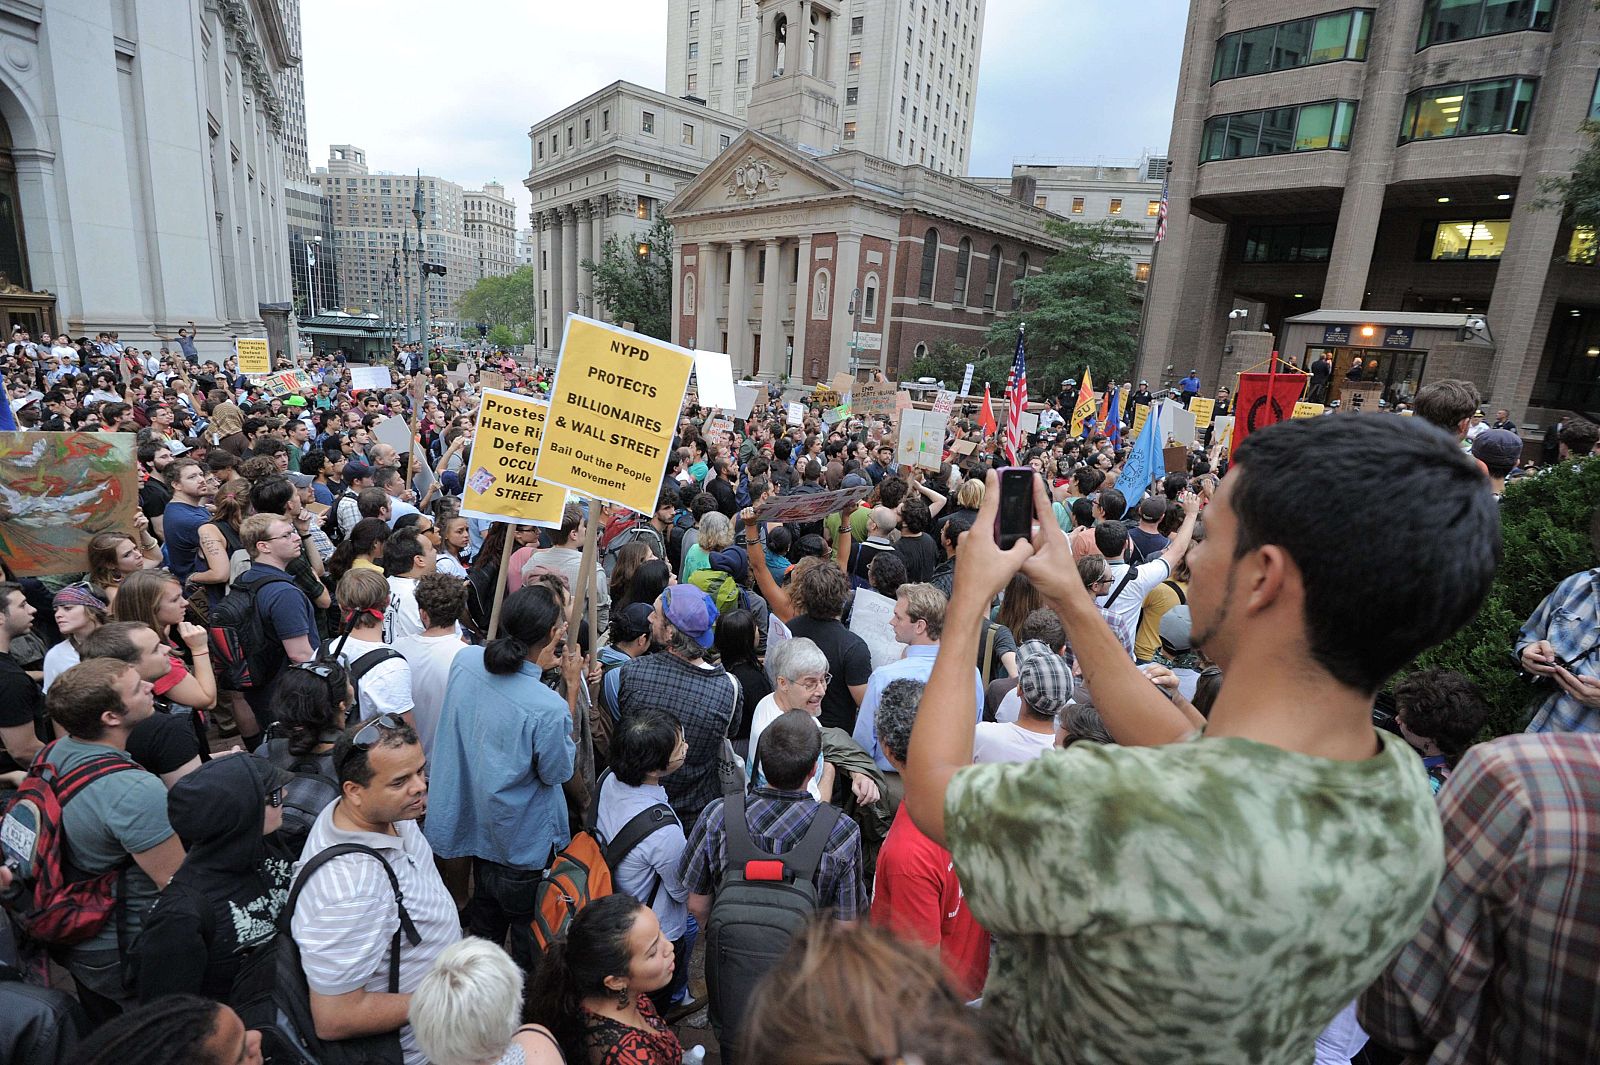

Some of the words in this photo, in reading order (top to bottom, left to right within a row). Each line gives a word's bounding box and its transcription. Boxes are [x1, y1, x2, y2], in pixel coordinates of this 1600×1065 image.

[610, 340, 649, 362] NYPD
[280, 372, 302, 390] MY
[587, 366, 657, 398] PROTECTS
[566, 392, 662, 433] BILLIONAIRES
[481, 416, 520, 434] Have
[555, 416, 567, 429] &
[571, 419, 606, 442] WALL
[609, 434, 660, 459] STREET
[550, 442, 572, 456] Bail
[575, 450, 593, 464] Out
[595, 456, 613, 470] the
[616, 463, 652, 483] People
[505, 473, 539, 488] WALL
[570, 465, 626, 491] Movement
[495, 487, 543, 503] STREET
